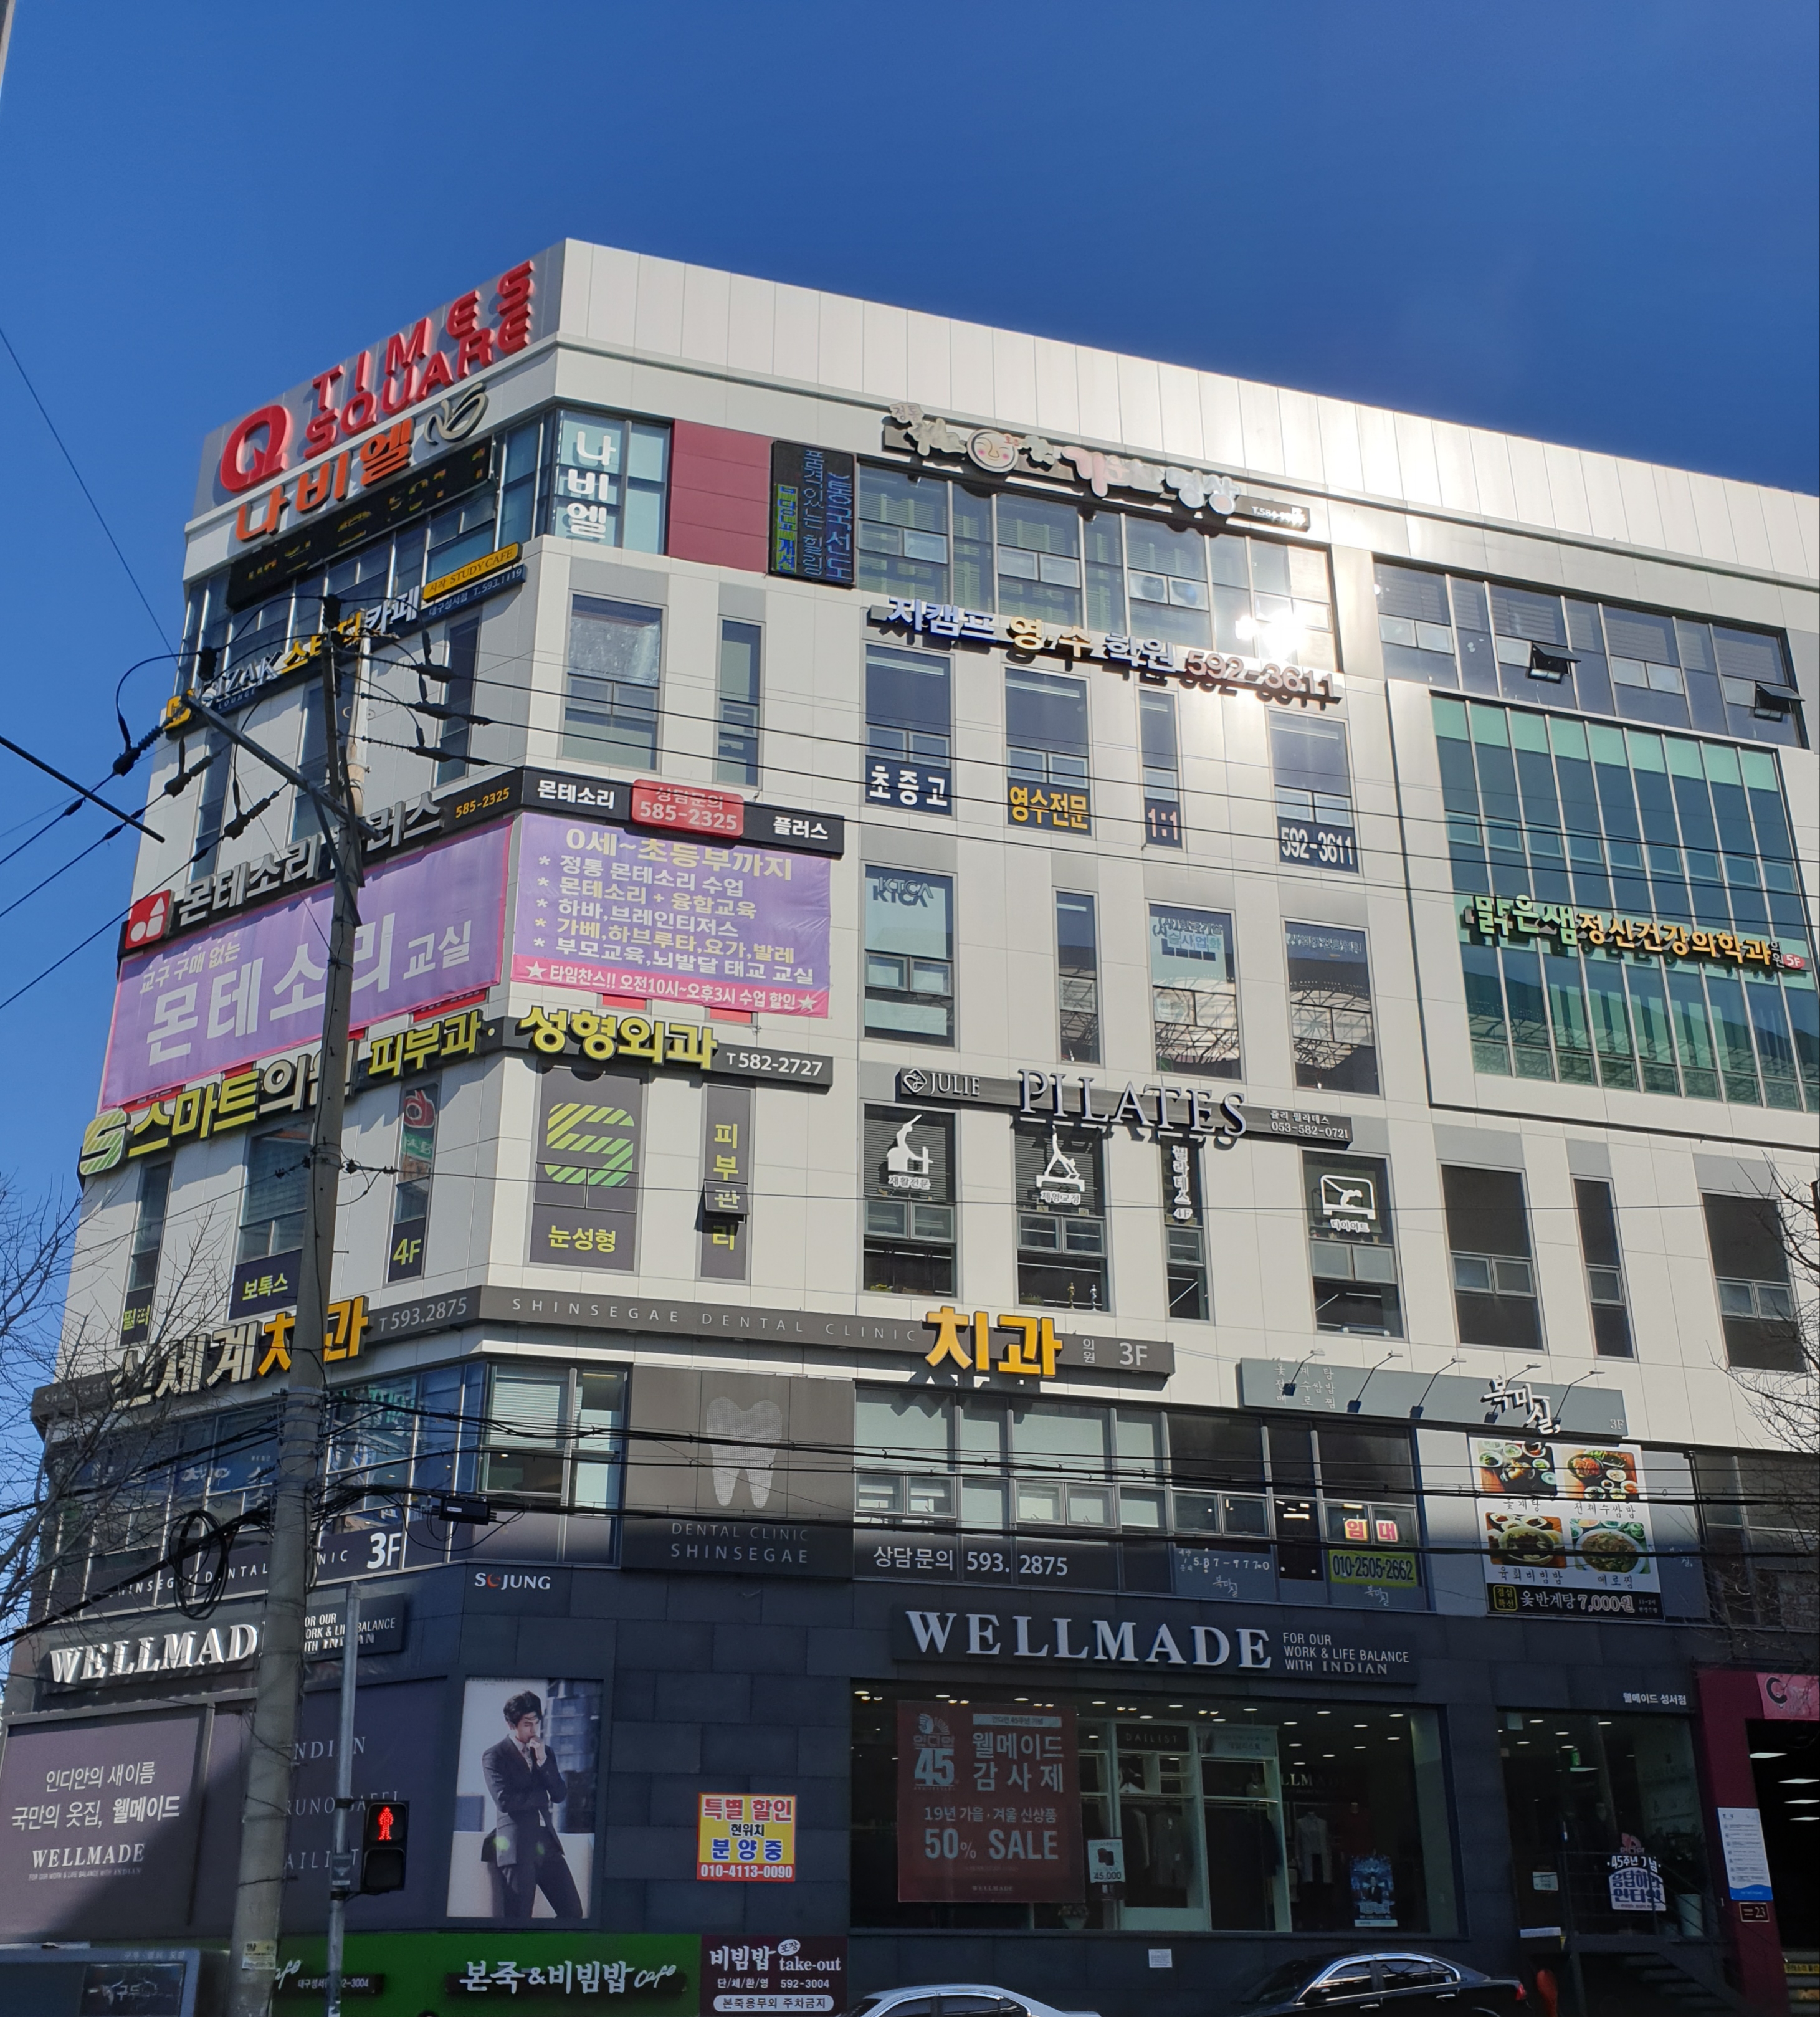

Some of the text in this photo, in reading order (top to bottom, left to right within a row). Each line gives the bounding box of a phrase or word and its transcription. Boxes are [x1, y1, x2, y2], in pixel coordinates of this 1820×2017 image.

[312, 260, 534, 412] TIMES
[303, 303, 532, 460] SQUARE
[235, 417, 414, 542] 나비엘
[566, 431, 617, 540] 나비엘
[450, 561, 484, 584] STUDY
[485, 549, 513, 568] CAFE
[887, 596, 996, 639] 지캠프
[1104, 632, 1176, 674] 학원
[1185, 651, 1336, 699] 592-3611
[536, 778, 615, 810] 몬테소리
[654, 786, 723, 811] 상담문의
[1009, 785, 1090, 830] 영수전문
[639, 801, 738, 831] 585-2325
[772, 814, 829, 841] 플러스
[1147, 808, 1179, 841] 1:1
[178, 786, 510, 926] 몬테소리 585-2325
[1280, 825, 1354, 867] 592-3611
[559, 854, 745, 898] 정통 몬테소리 수업
[559, 876, 647, 905] 몬테소리
[670, 892, 758, 920] 융합교육
[140, 941, 241, 994] 교구 구매 없는
[723, 960, 766, 981] 태교
[772, 964, 814, 986] 교실
[1785, 955, 1801, 967] 5F
[146, 912, 472, 1068] 몬테소리 교실
[739, 989, 766, 1008] 수업
[769, 991, 797, 1011] 할인
[368, 1009, 483, 1077] 피부과
[520, 1005, 718, 1069] 성형외과
[738, 1052, 823, 1077] 582-2727
[930, 1068, 1247, 1138] JULIE PILATES
[1270, 1122, 1349, 1140] 053-582-0721
[1292, 1111, 1330, 1125] 필라테스
[548, 1224, 616, 1253] 눈성형
[1330, 1219, 1370, 1233] 다이어트
[393, 1238, 422, 1266] 4F
[242, 1272, 288, 1301] 보톡스
[389, 1297, 467, 1331] 593.2875
[512, 1297, 917, 1343] SHINSEGAE DENTAL CLINIC
[925, 1305, 1064, 1378] 치과
[1119, 1342, 1148, 1366] 3F
[1609, 1419, 1624, 1431] 3F
[671, 1521, 809, 1543] DENTAL CLINIC
[205, 1531, 402, 1583] DNTAL 3F
[670, 1543, 809, 1565] SHINSEGAE
[873, 1545, 954, 1573] 상담문의
[1332, 1554, 1414, 1581] 010-2505-2662
[305, 1613, 336, 1628] OR OUR
[305, 1627, 323, 1640] ORK
[49, 1621, 262, 1684] WELLMAD
[304, 1639, 318, 1652] ITH
[905, 1610, 1272, 1671] WELLMADE
[1283, 1632, 1332, 1646] FOR OUR
[1284, 1646, 1410, 1663] WORK & LIFE BALANCE
[1285, 1659, 1388, 1675] WITH INDIAN
[1660, 1694, 1687, 1706] 성서점
[293, 1736, 367, 1760] NDIN
[972, 1732, 1065, 1761] 웰메이드
[1125, 1732, 1178, 1745] DAILIST
[45, 1761, 155, 1793] 인디안의 새이름
[913, 1747, 955, 1786] 45
[113, 1795, 180, 1824] 웰메이드
[703, 1798, 793, 1823] 특별 할인
[924, 1806, 1058, 1824] 19년 가을 겨울 신상품
[730, 1823, 765, 1838] 현위치
[924, 1828, 1059, 1861] 50% SALE
[32, 1843, 145, 1869] WELLMADE
[284, 1848, 360, 1871] AILIT
[700, 1864, 793, 1879] 010-4113-0090
[709, 1944, 776, 1972] 비빔밥
[778, 1956, 842, 1973] take-out
[297, 1978, 328, 1990] 대구성서
[633, 1962, 678, 1989] cafe
[780, 1977, 830, 1990] 592-3004
[722, 1996, 826, 2011] 본죽용무외 주차금지
